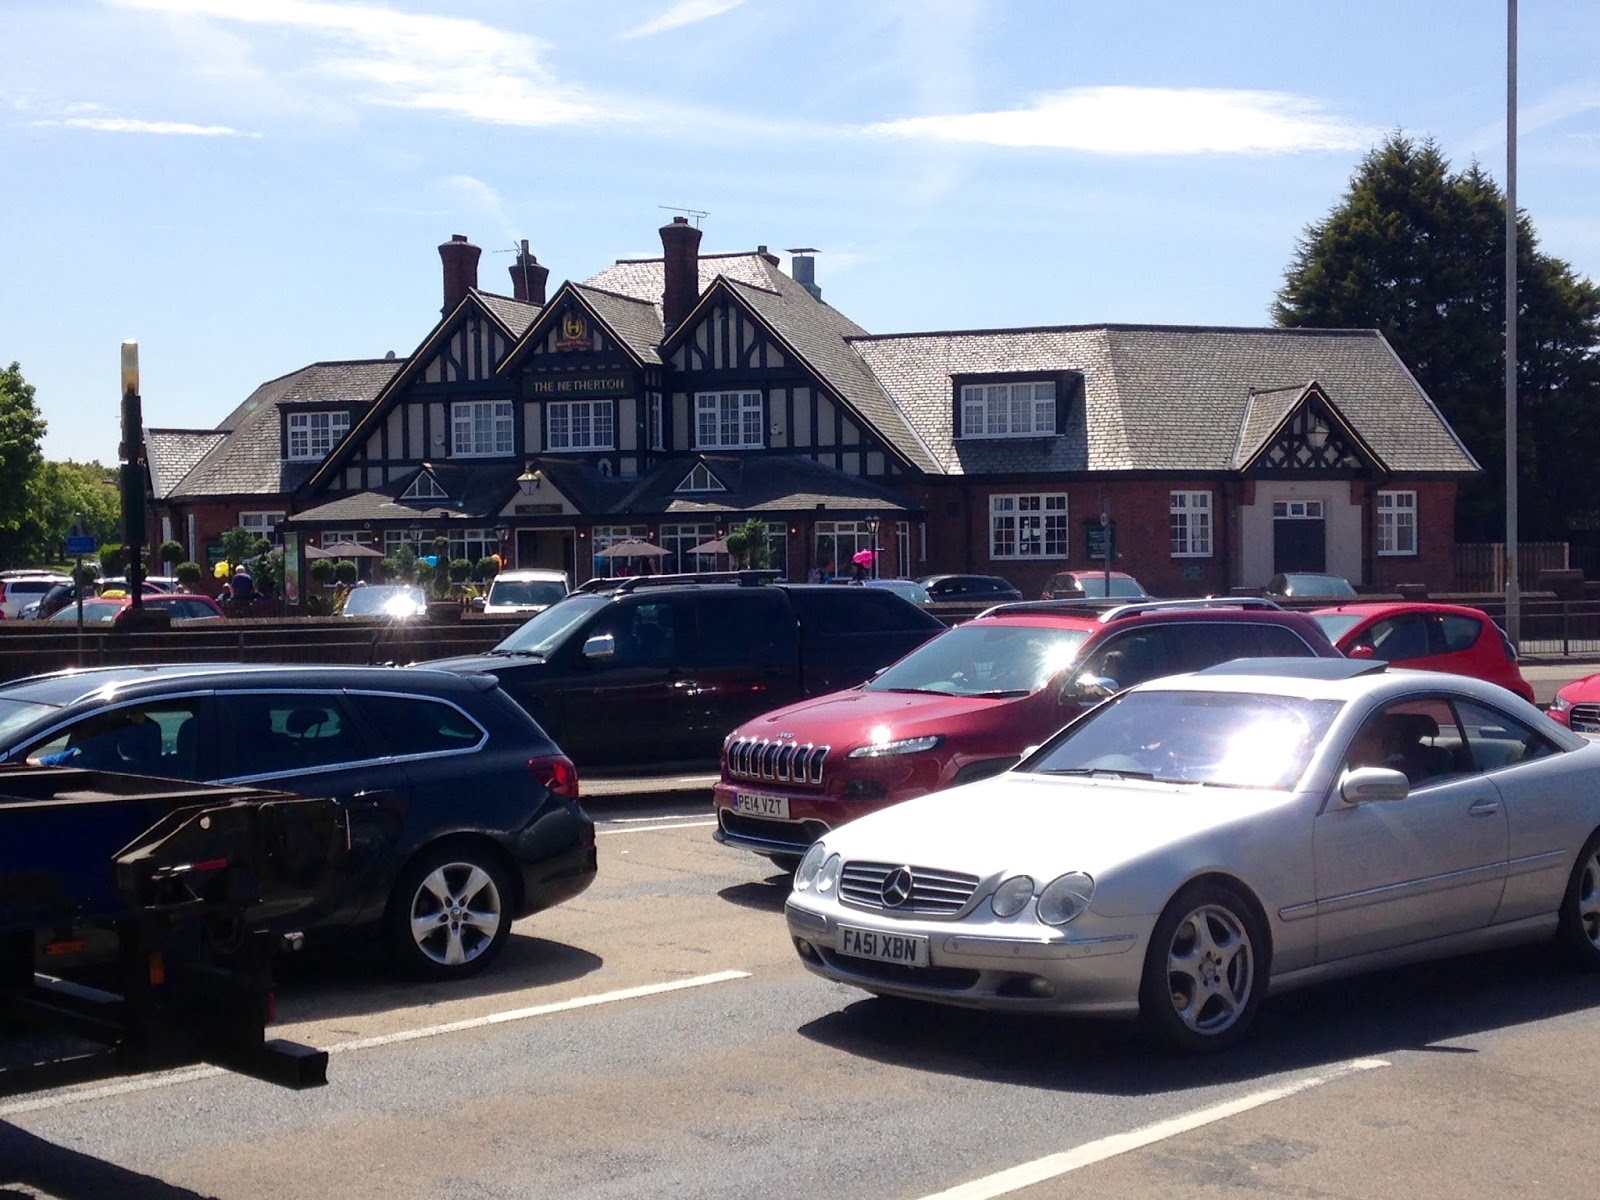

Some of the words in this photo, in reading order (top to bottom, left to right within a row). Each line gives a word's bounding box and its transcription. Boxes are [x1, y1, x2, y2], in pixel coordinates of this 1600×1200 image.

[534, 381, 554, 392] THE
[557, 379, 624, 391] NETHERTON
[738, 795, 760, 811] PE14
[763, 799, 782, 815] VZT
[843, 930, 878, 956] FA51
[881, 935, 917, 961] XBN
